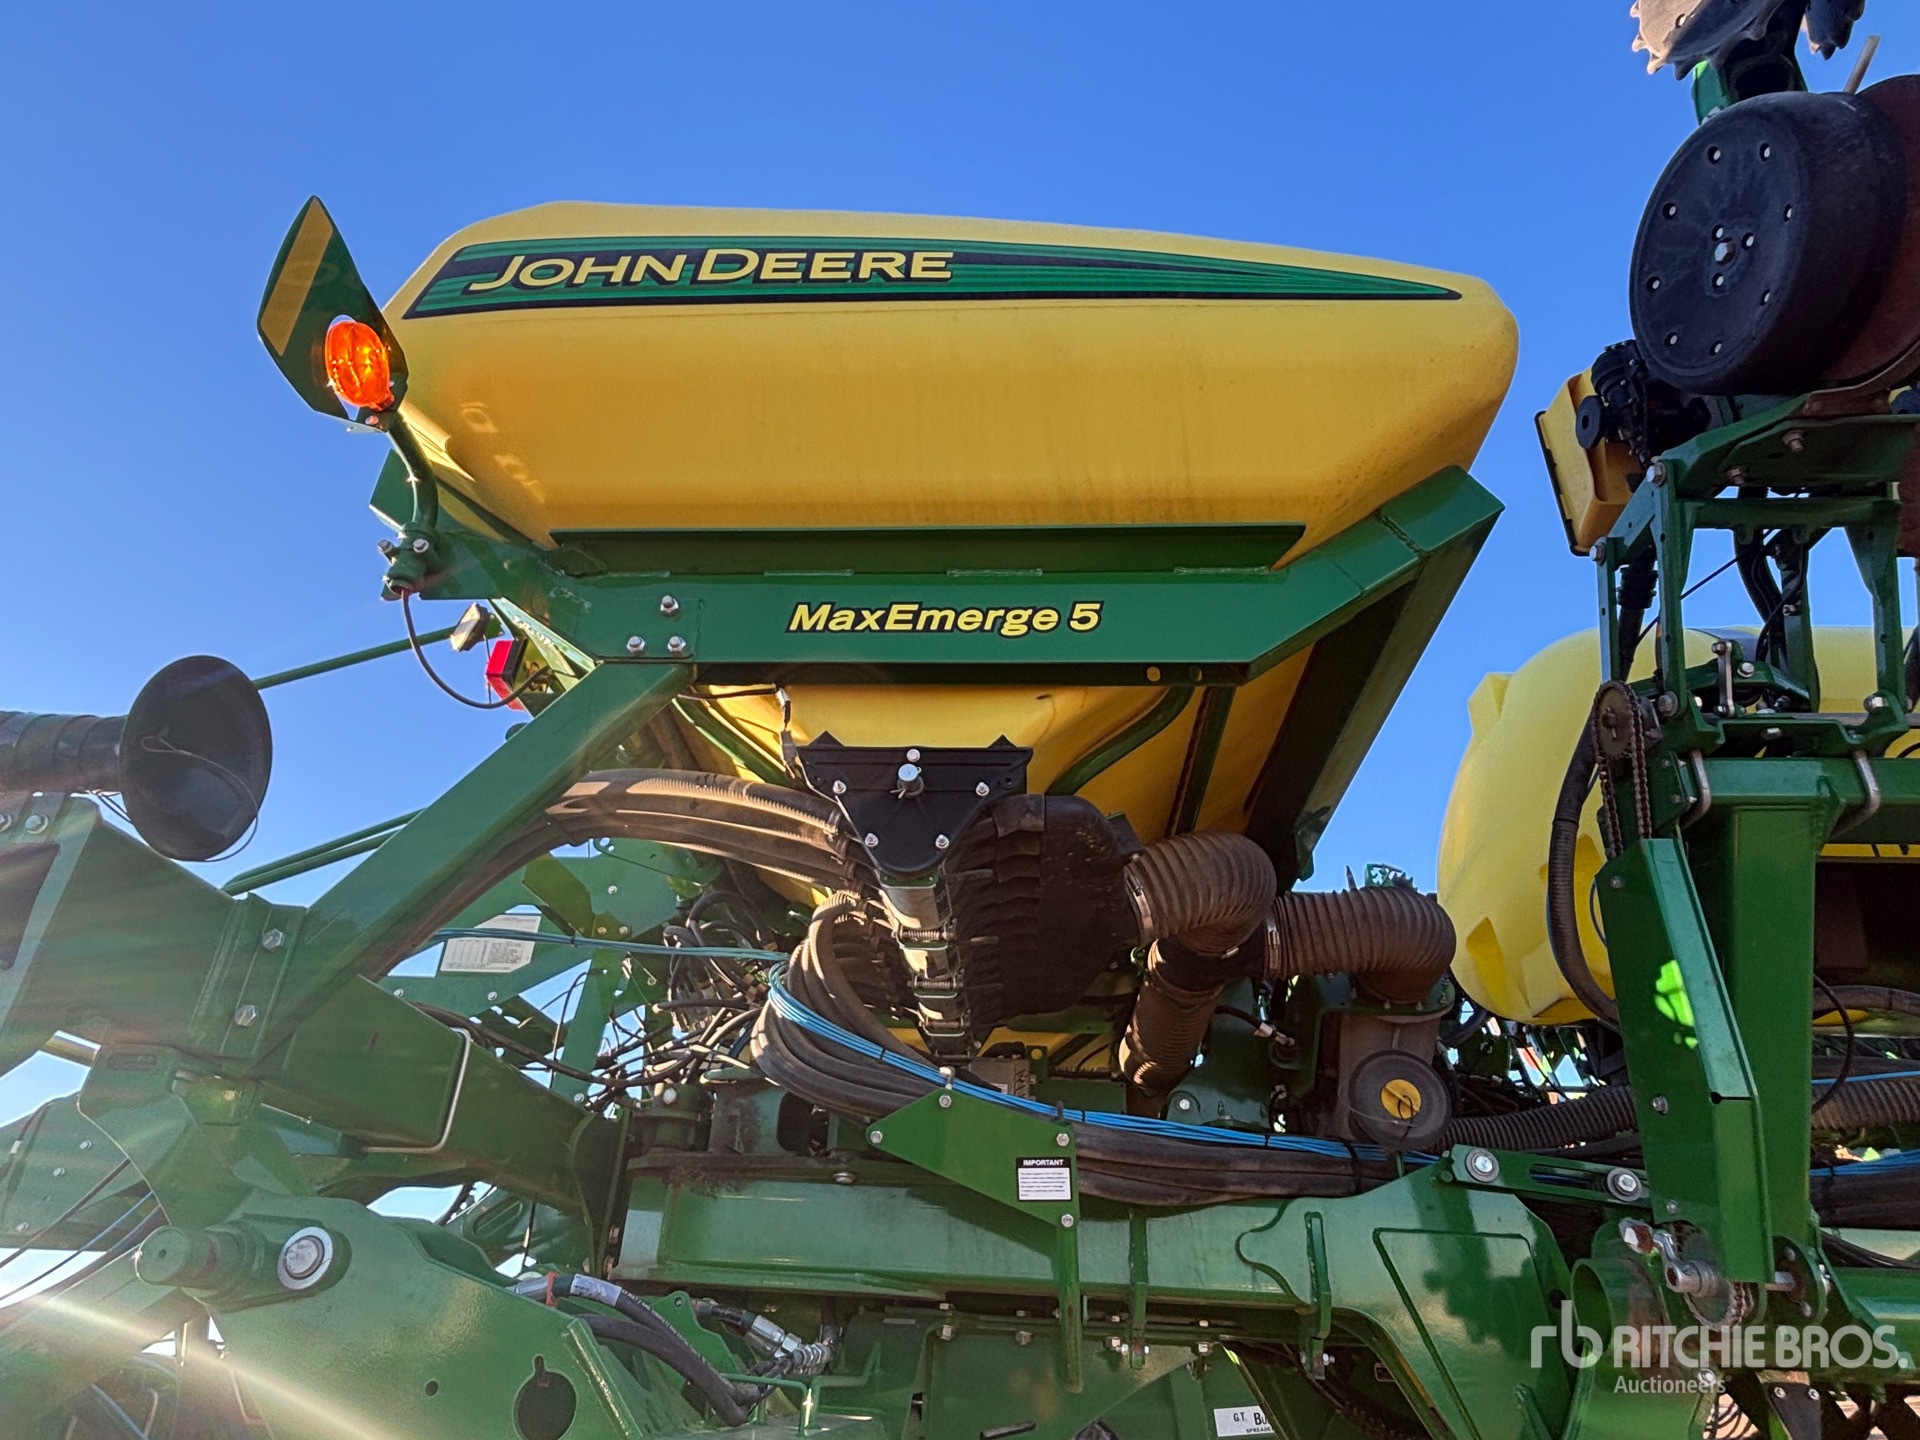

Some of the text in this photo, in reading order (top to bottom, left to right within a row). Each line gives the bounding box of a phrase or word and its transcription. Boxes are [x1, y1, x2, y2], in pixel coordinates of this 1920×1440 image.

[469, 248, 954, 292] JOHN DEERE
[788, 603, 1101, 637] MaxEmerge 5
